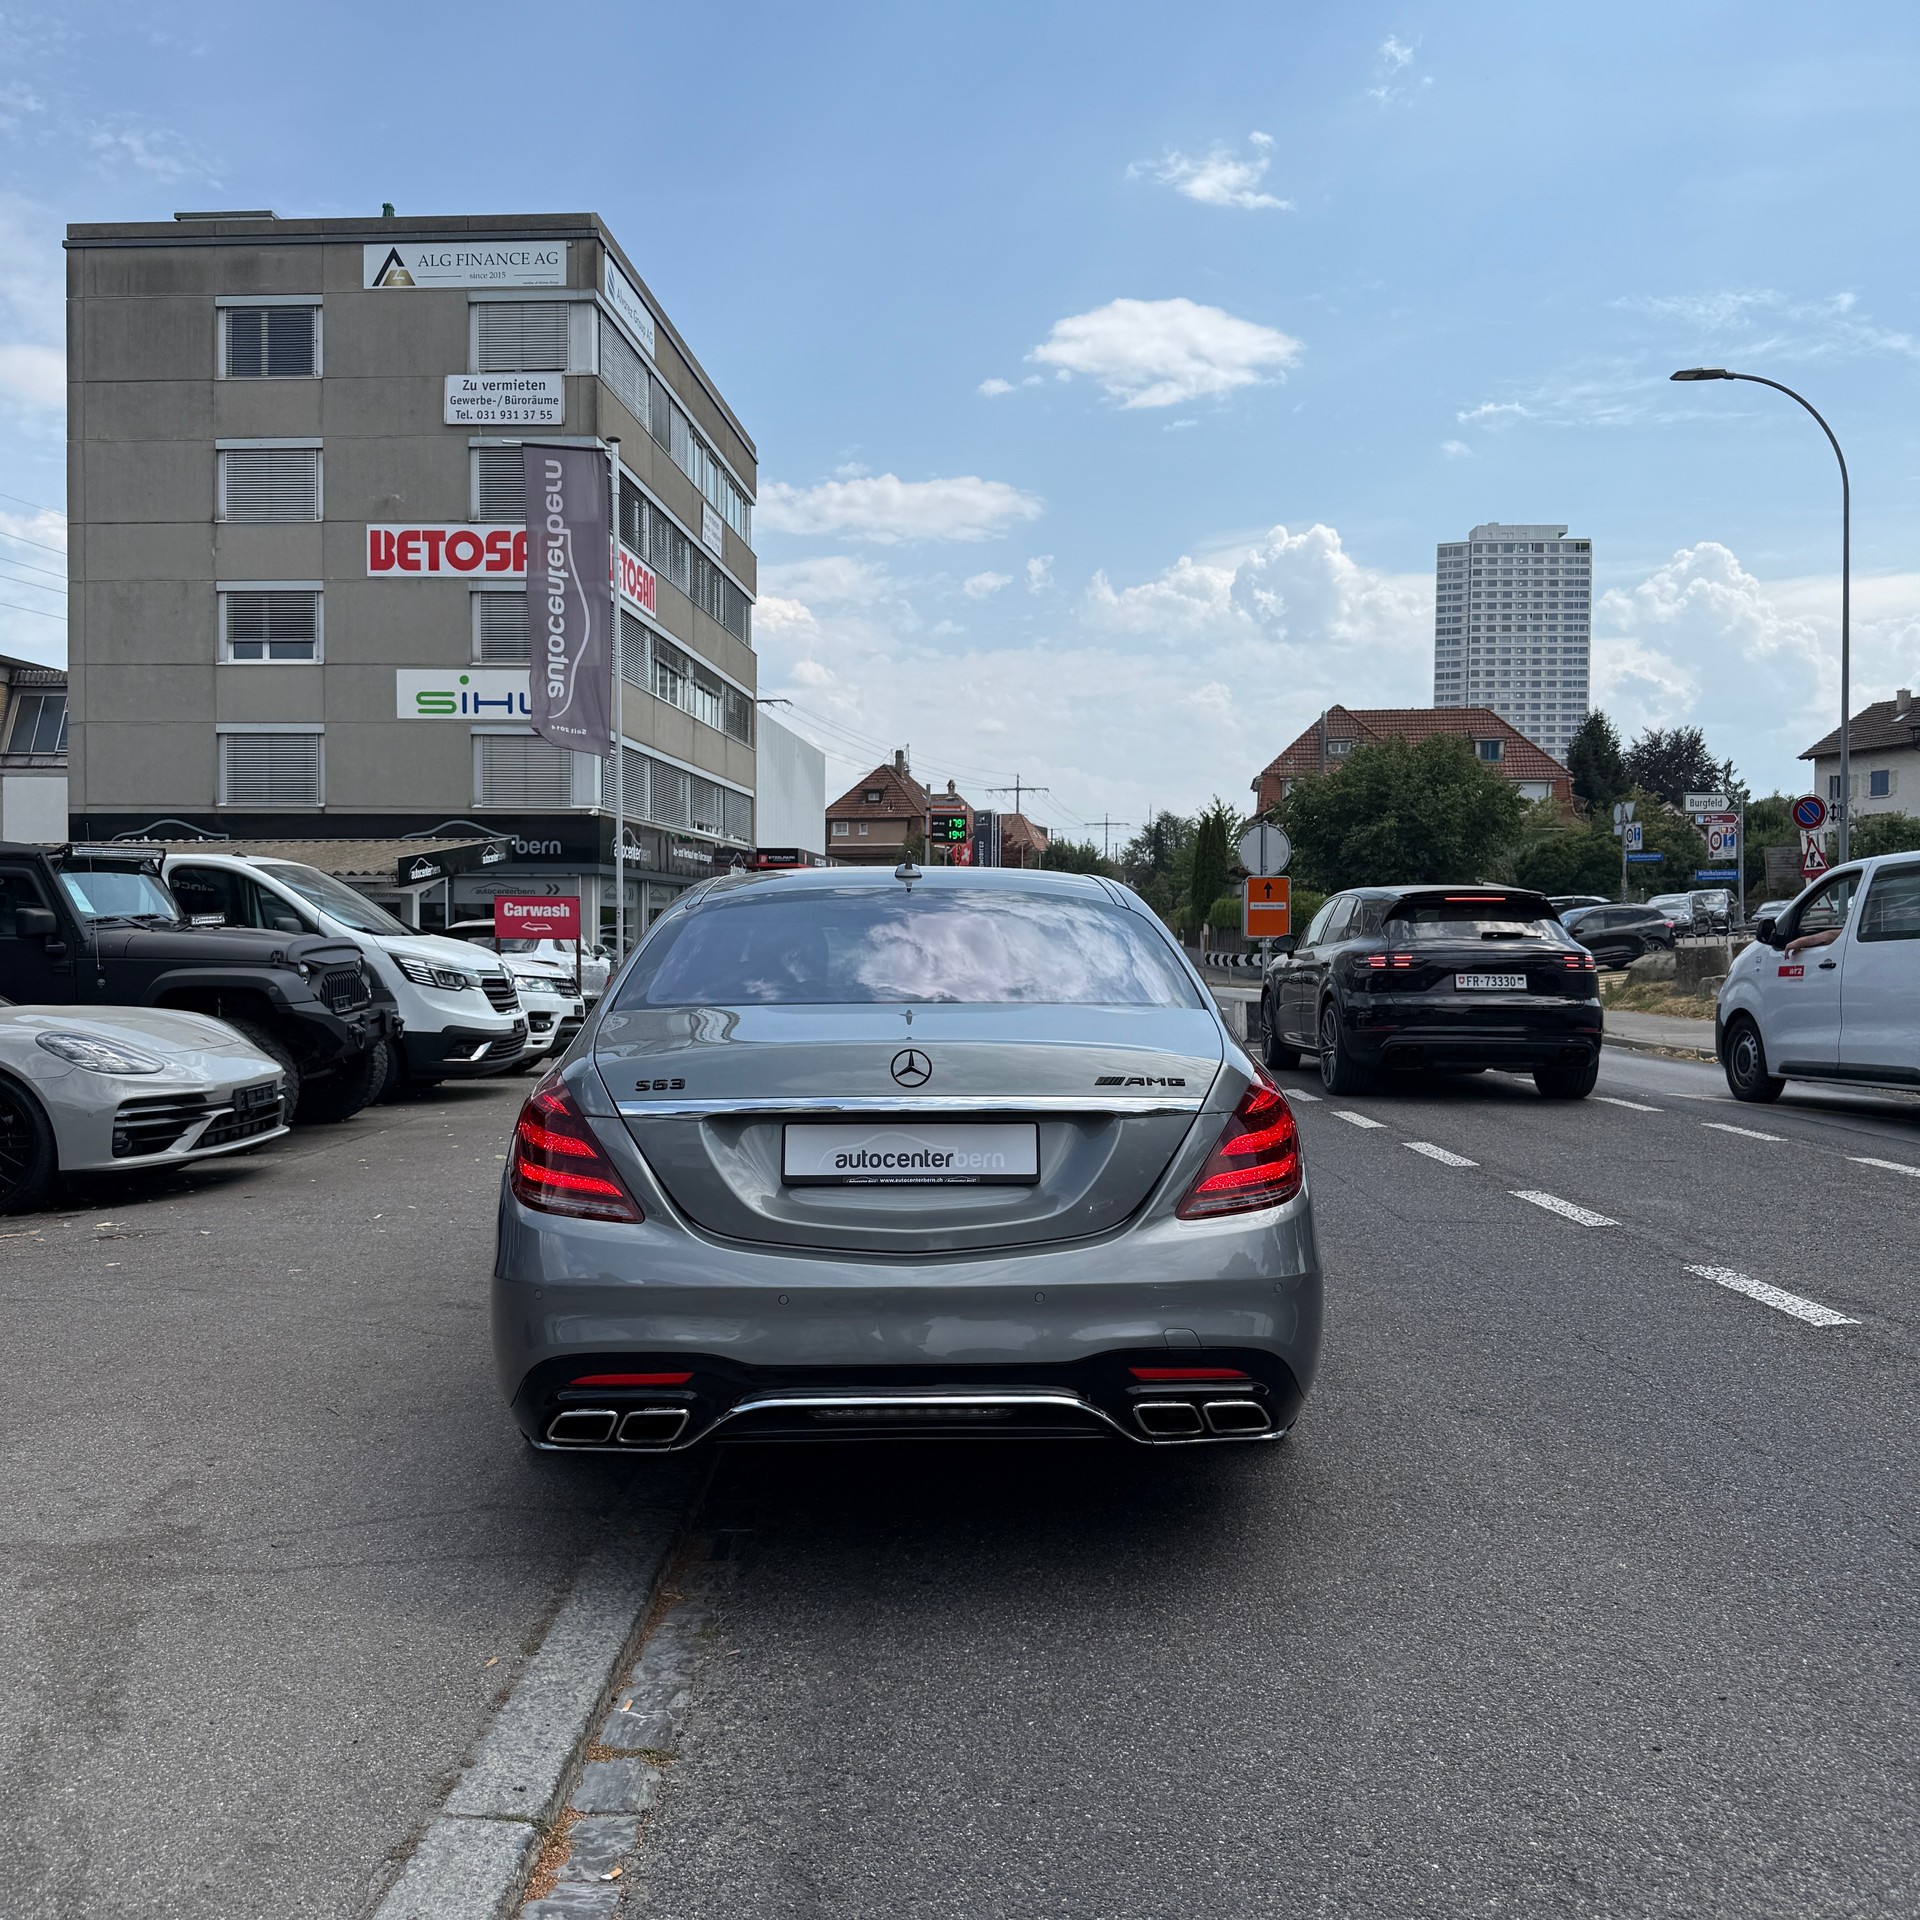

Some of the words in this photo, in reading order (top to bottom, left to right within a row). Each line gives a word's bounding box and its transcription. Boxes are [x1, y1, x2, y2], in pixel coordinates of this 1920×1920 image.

[418, 254, 452, 267] ALG
[456, 252, 530, 266] FINANCE
[534, 251, 559, 265] AG
[469, 272, 488, 280] since
[489, 271, 506, 279] 2015
[616, 287, 633, 319] Alvarez
[633, 310, 646, 338] Group
[462, 379, 477, 391] Zu
[482, 379, 546, 391] vermieten
[504, 395, 560, 405] Büroräume
[456, 410, 473, 420] Tel.
[476, 410, 496, 420] 031
[500, 410, 519, 420] 931
[523, 410, 536, 420] 37
[540, 410, 553, 420] 55
[370, 530, 528, 571] BETOSA
[1689, 798, 1723, 809] Burgfeld
[503, 902, 570, 917] Carwash
[634, 1078, 686, 1092] S63
[1124, 1077, 1186, 1087] AMG
[835, 1149, 1005, 1169] autocenterbern
